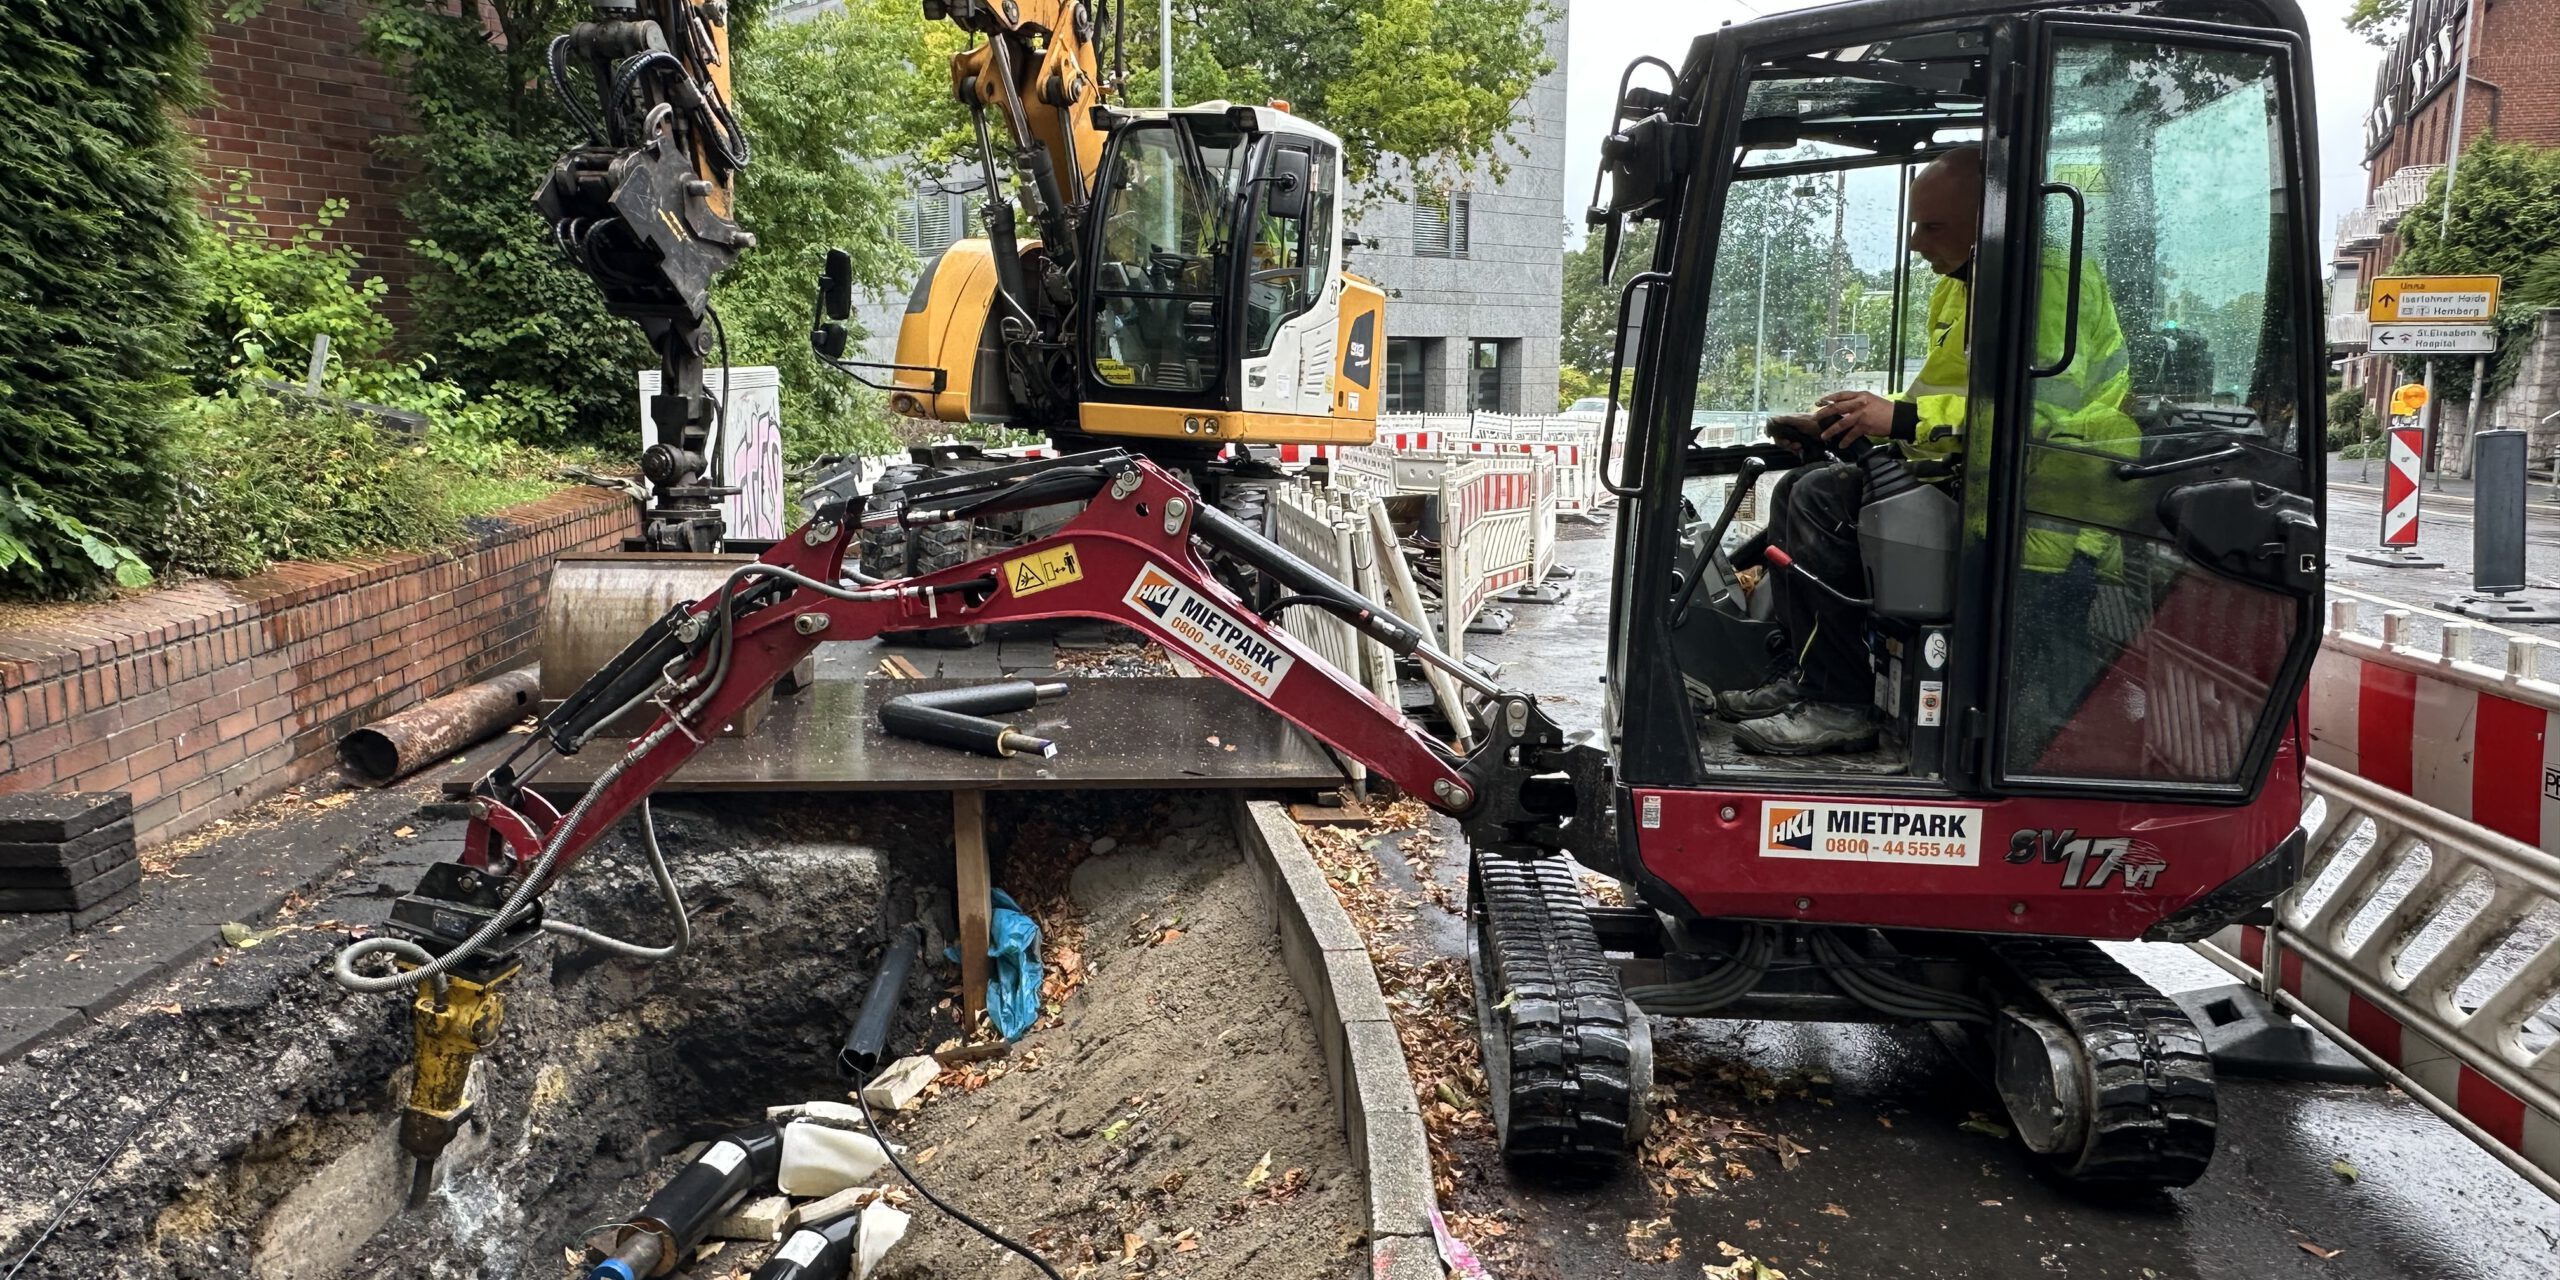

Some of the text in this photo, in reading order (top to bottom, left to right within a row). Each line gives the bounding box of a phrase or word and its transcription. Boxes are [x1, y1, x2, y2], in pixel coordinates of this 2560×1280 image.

[2400, 282, 2426, 290] Unna
[2402, 294, 2486, 304] Iserlohner Heide
[2415, 340, 2456, 349] Hospital
[1137, 584, 1176, 607] HKL
[1179, 596, 1283, 674] MIETPARK
[1170, 616, 1204, 645] 0800
[1209, 643, 1228, 660] 44
[1226, 654, 1252, 676] 555
[1250, 670, 1270, 687] 44
[1933, 639, 1946, 660] OK
[1772, 810, 1812, 843] HKL
[1827, 810, 1967, 838] MIETPARK
[1825, 838, 1869, 854] 0800
[1883, 841, 1904, 856] 44
[1908, 842, 1941, 857] 555
[1944, 843, 1966, 858] 44
